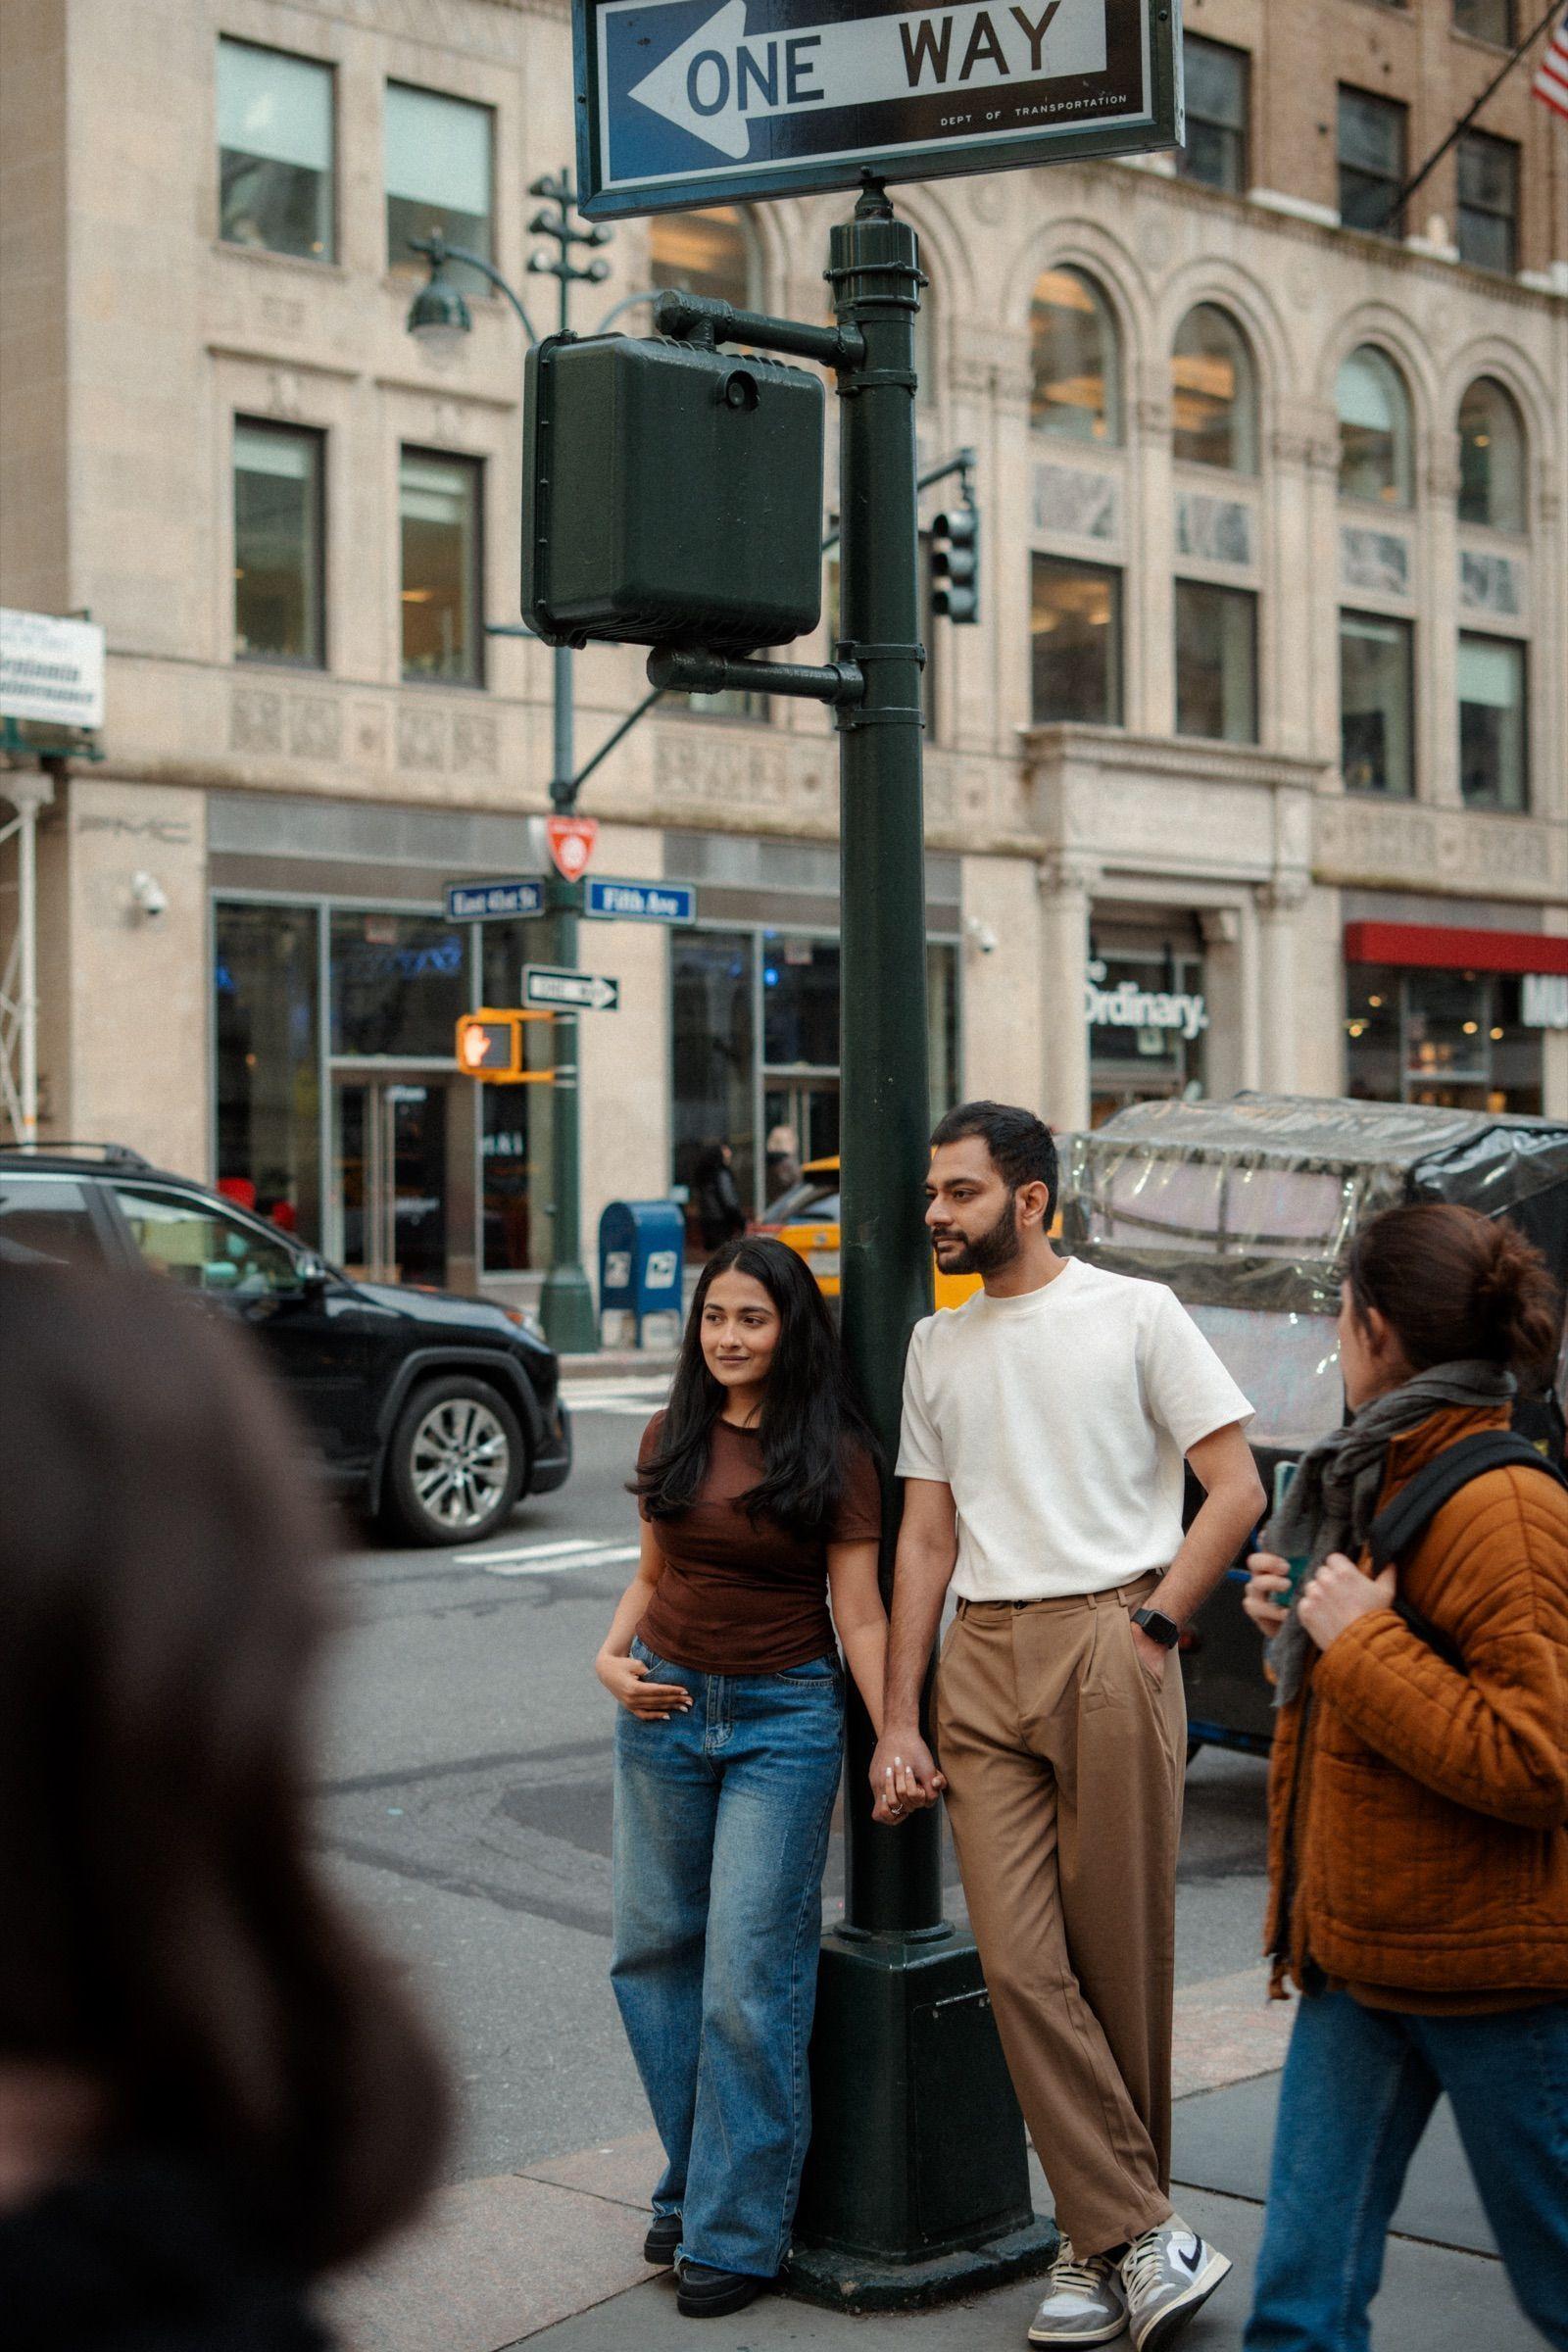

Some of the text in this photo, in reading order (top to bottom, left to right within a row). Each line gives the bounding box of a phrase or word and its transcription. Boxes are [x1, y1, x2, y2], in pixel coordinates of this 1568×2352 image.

[687, 1, 1061, 117] ONE WAY
[940, 94, 1127, 126] DEPT OF TRANSPORTATION
